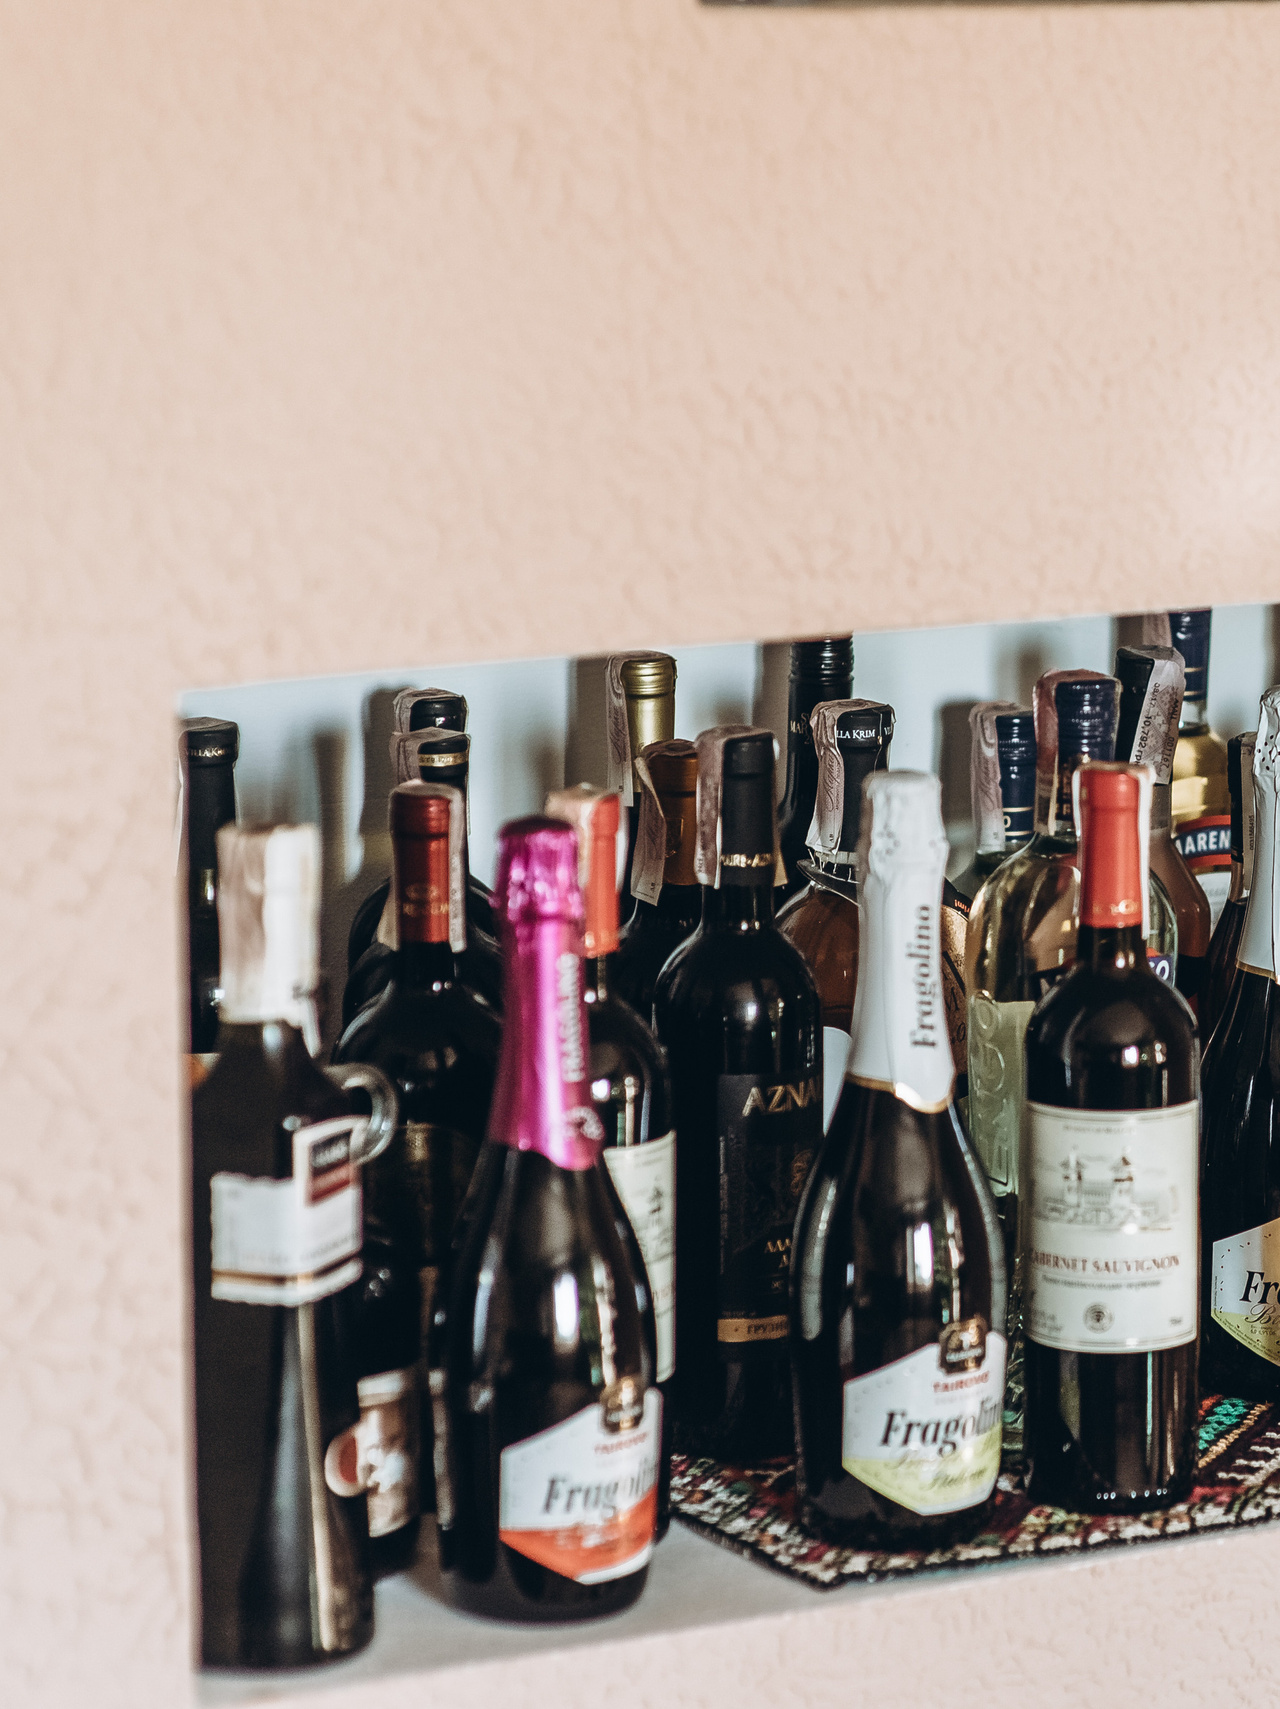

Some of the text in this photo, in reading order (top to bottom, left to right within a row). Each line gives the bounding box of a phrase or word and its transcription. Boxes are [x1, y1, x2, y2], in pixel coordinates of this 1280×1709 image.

[852, 729, 876, 740] KRIM
[905, 903, 938, 1050] Fragolino
[1033, 1249, 1089, 1273] ABERNET
